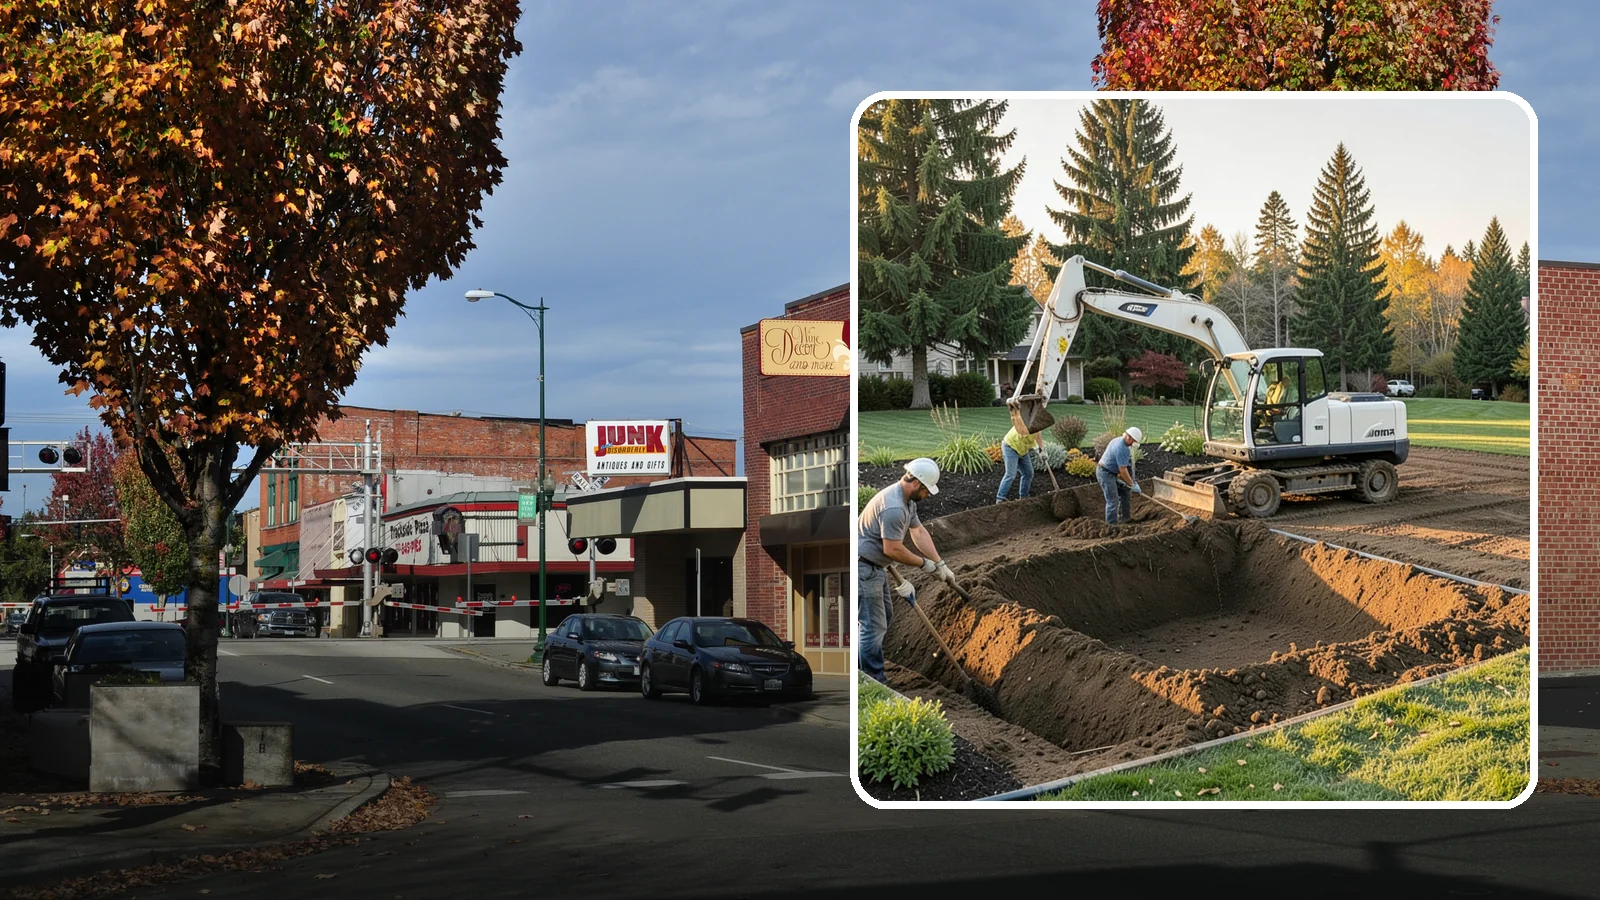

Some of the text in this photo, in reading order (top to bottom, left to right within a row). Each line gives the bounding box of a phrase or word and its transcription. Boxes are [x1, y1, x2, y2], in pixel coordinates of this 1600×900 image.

[595, 425, 665, 457] JUNK
[597, 460, 665, 470] ANTIQUES AND GIFTS
[390, 519, 429, 539] Trackside Pizza
